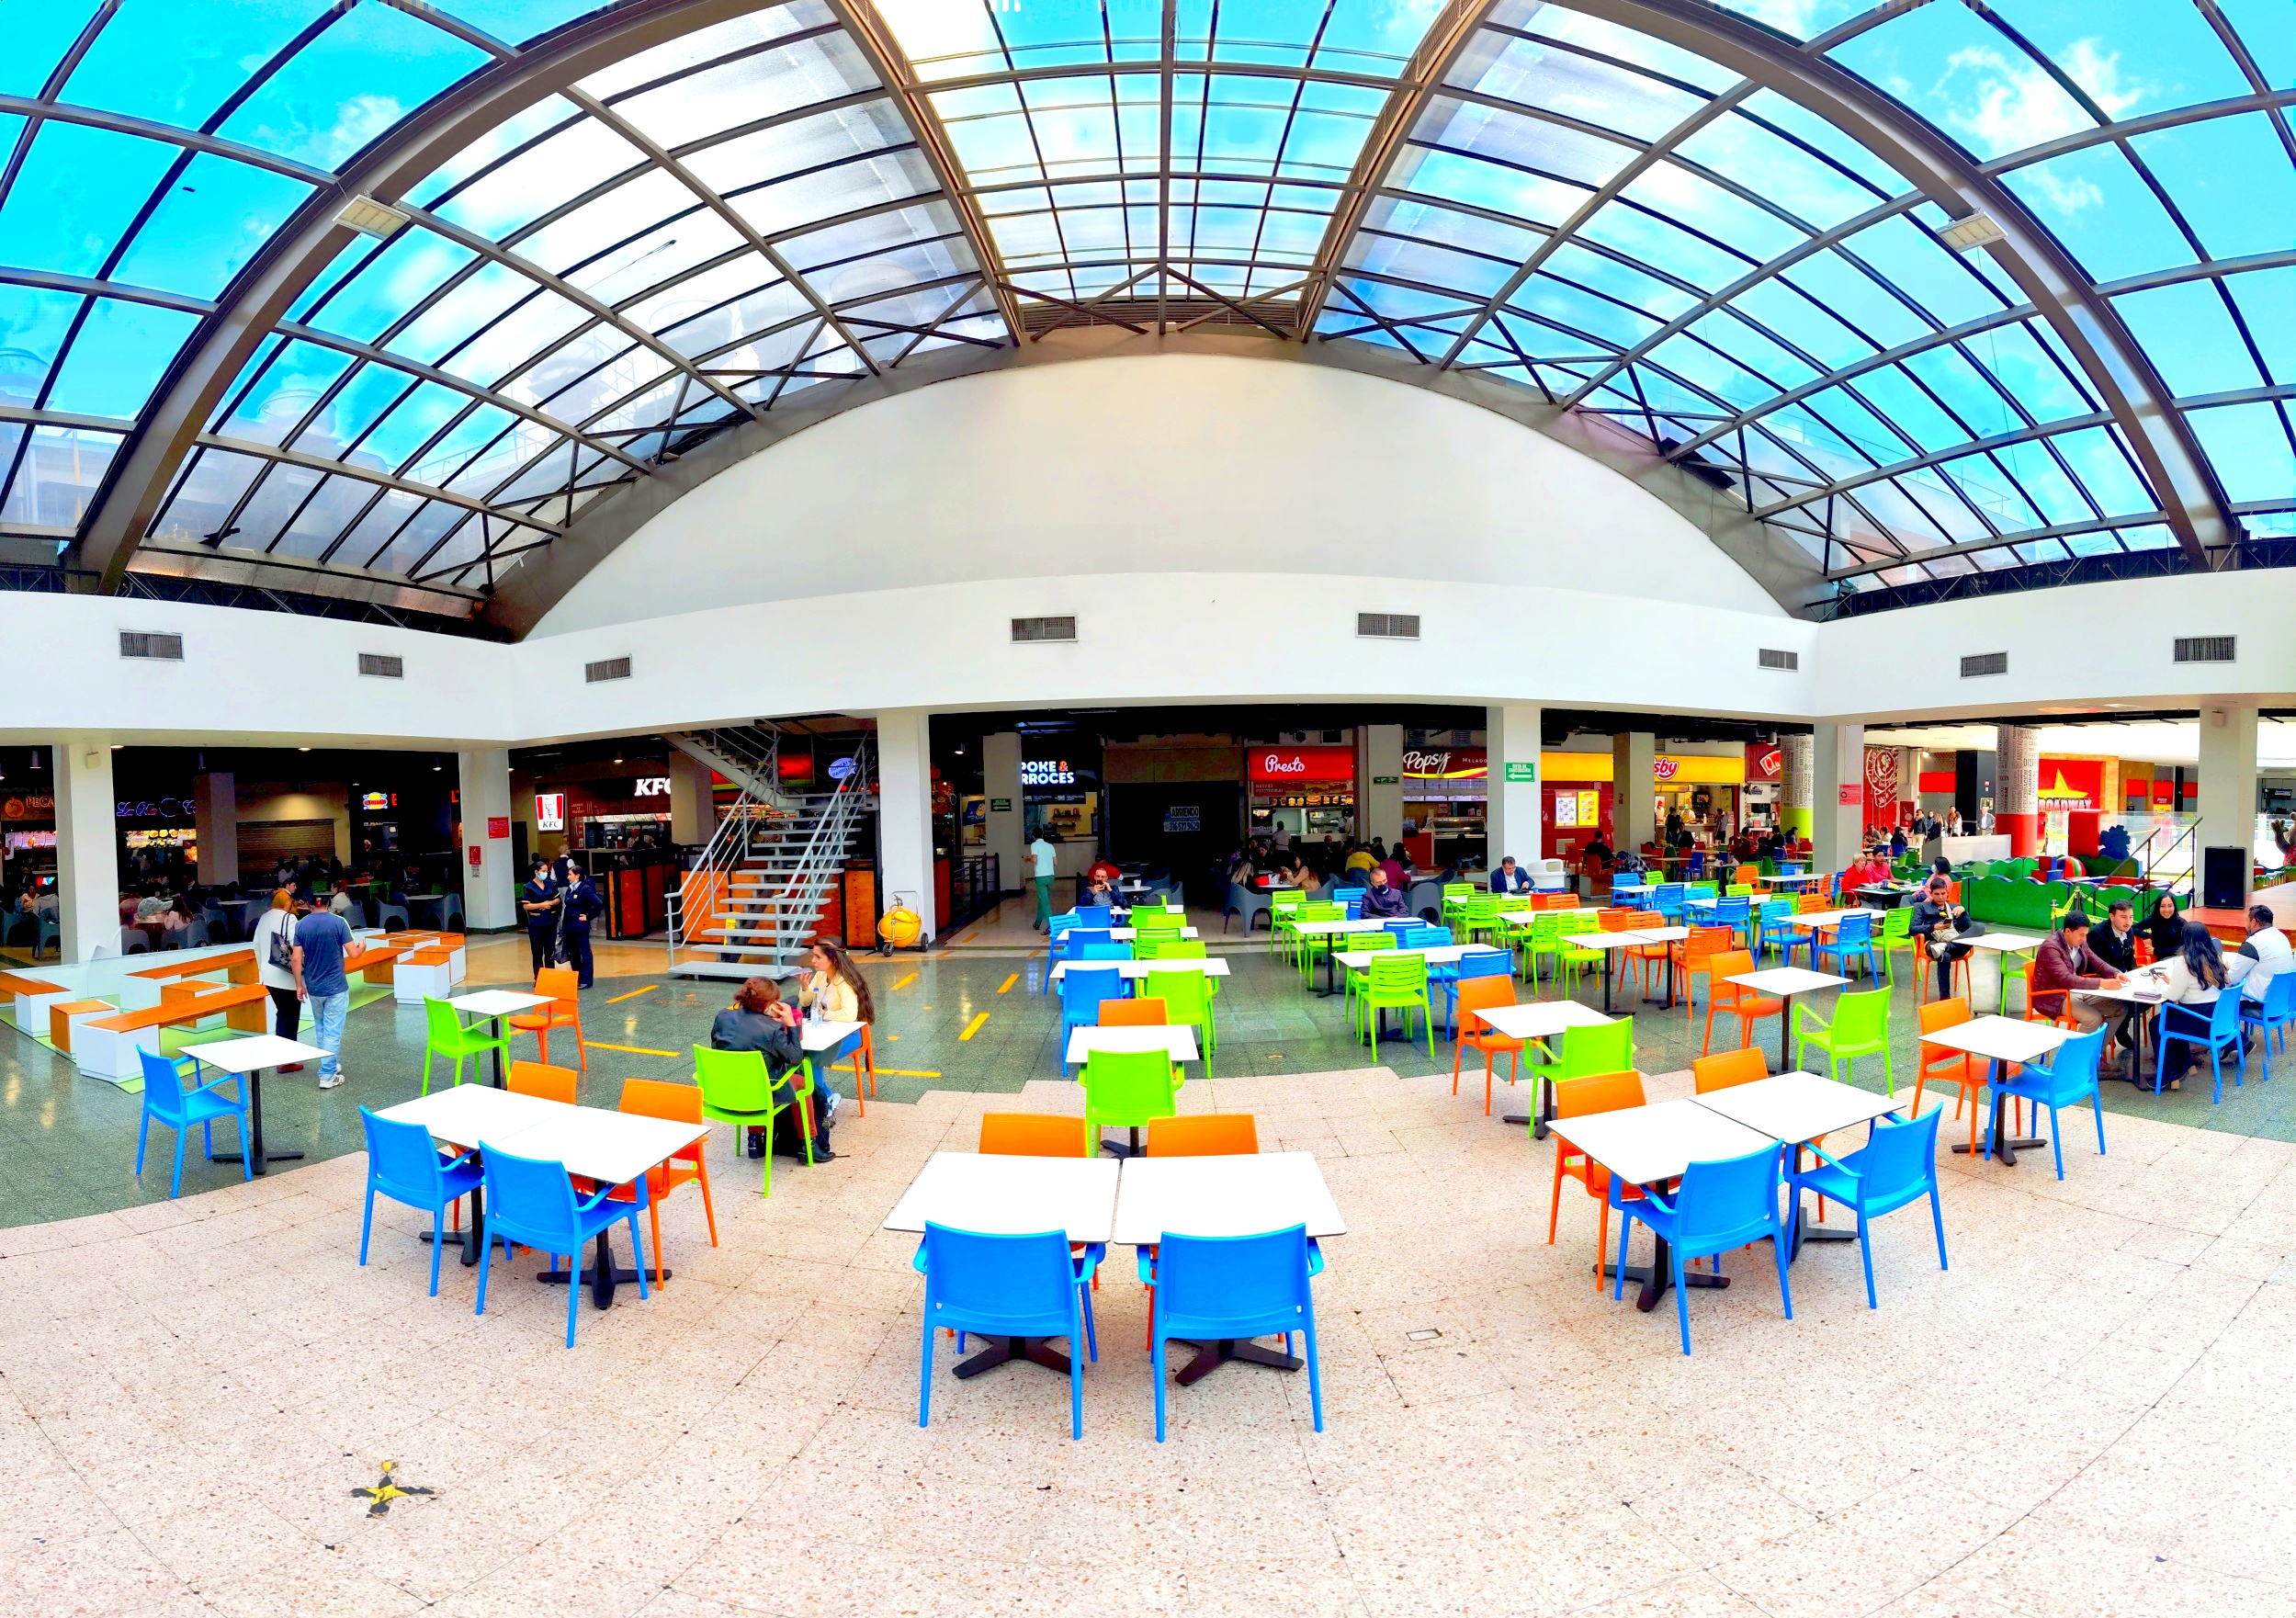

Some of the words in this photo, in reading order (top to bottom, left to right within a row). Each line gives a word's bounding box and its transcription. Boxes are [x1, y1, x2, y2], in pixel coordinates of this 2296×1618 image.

[1058, 761, 1069, 772] &
[1265, 754, 1305, 773] Presto
[1403, 751, 1451, 775] Popsy
[1022, 772, 1074, 785] RROCES
[26, 796, 54, 808] PECA
[2039, 798, 2092, 812] ROADWAY
[1171, 808, 1199, 818] ARRIENDO
[542, 820, 560, 829] KFC
